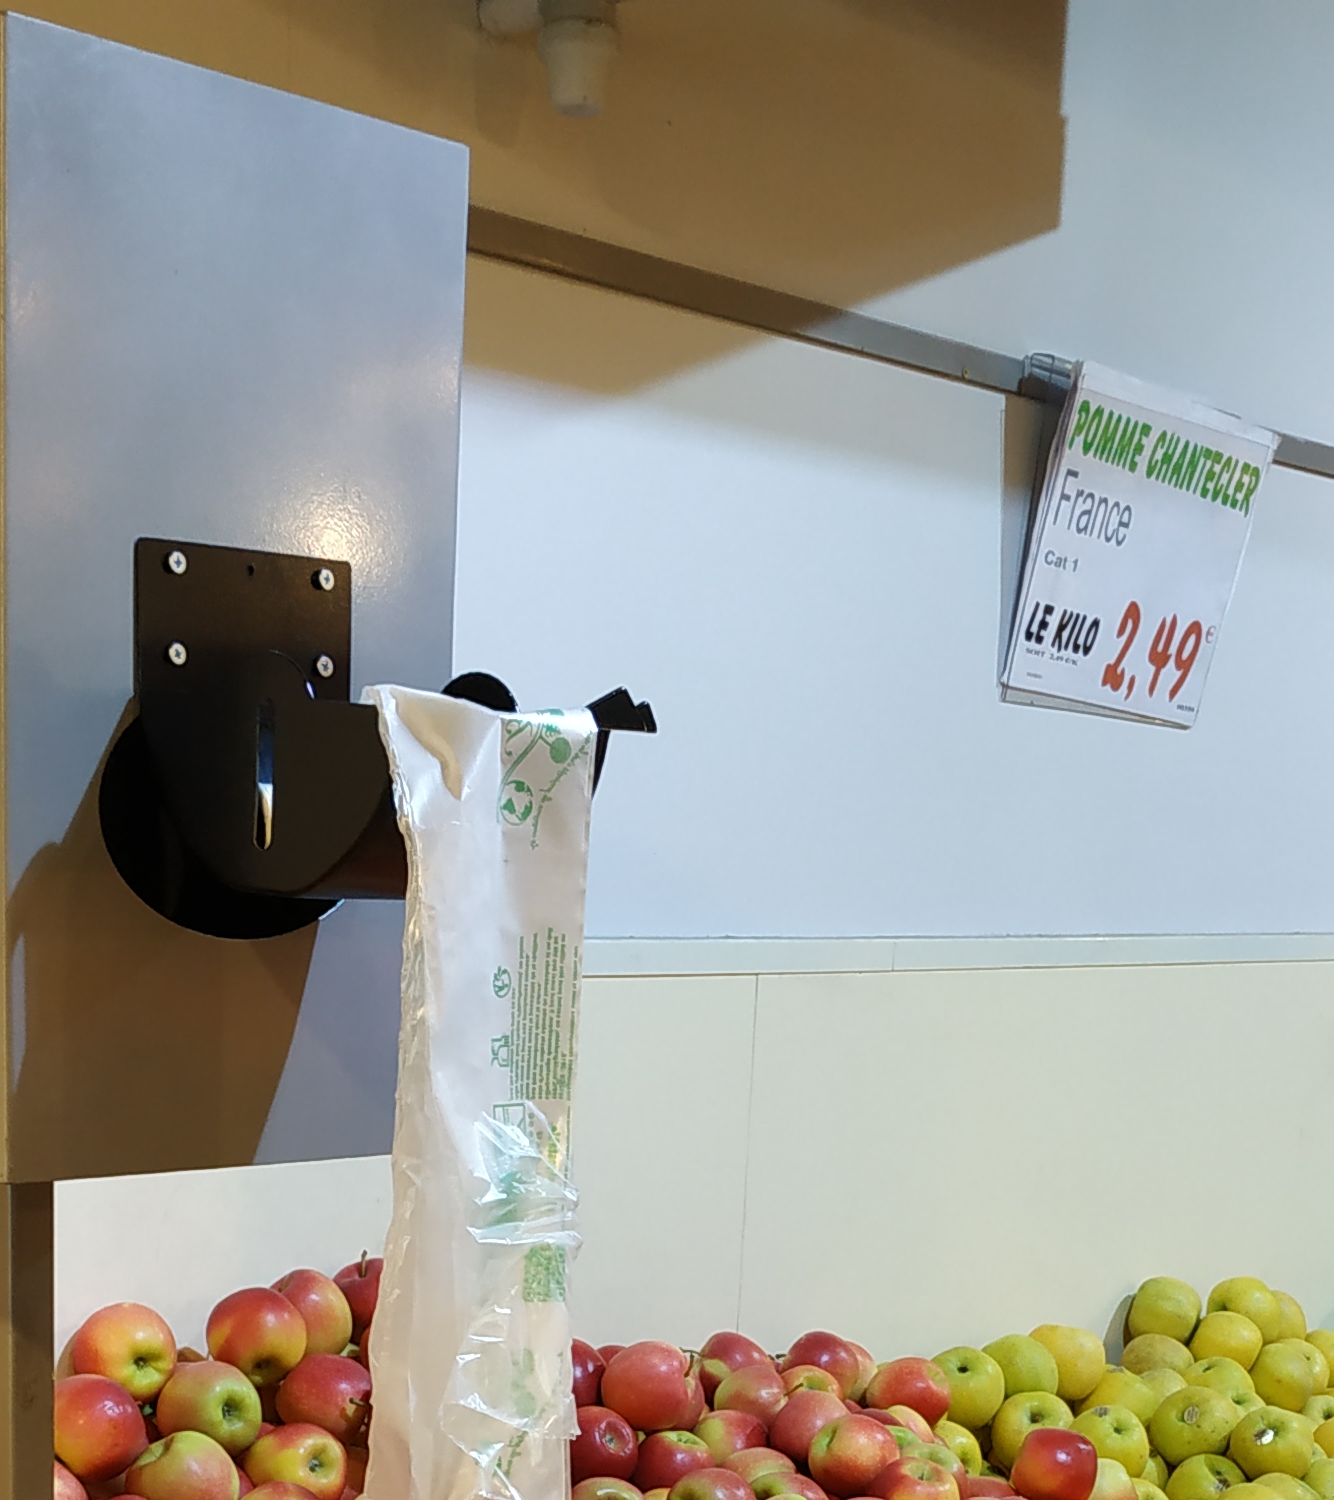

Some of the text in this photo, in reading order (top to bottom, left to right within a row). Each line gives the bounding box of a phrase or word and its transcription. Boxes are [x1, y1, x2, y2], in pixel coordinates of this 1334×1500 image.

[1068, 399, 1261, 517] POMME CHANTECLER
[1053, 468, 1132, 547] France
[1044, 549, 1069, 570] Cat
[1024, 601, 1054, 645] LE
[1051, 608, 1100, 657] KILO
